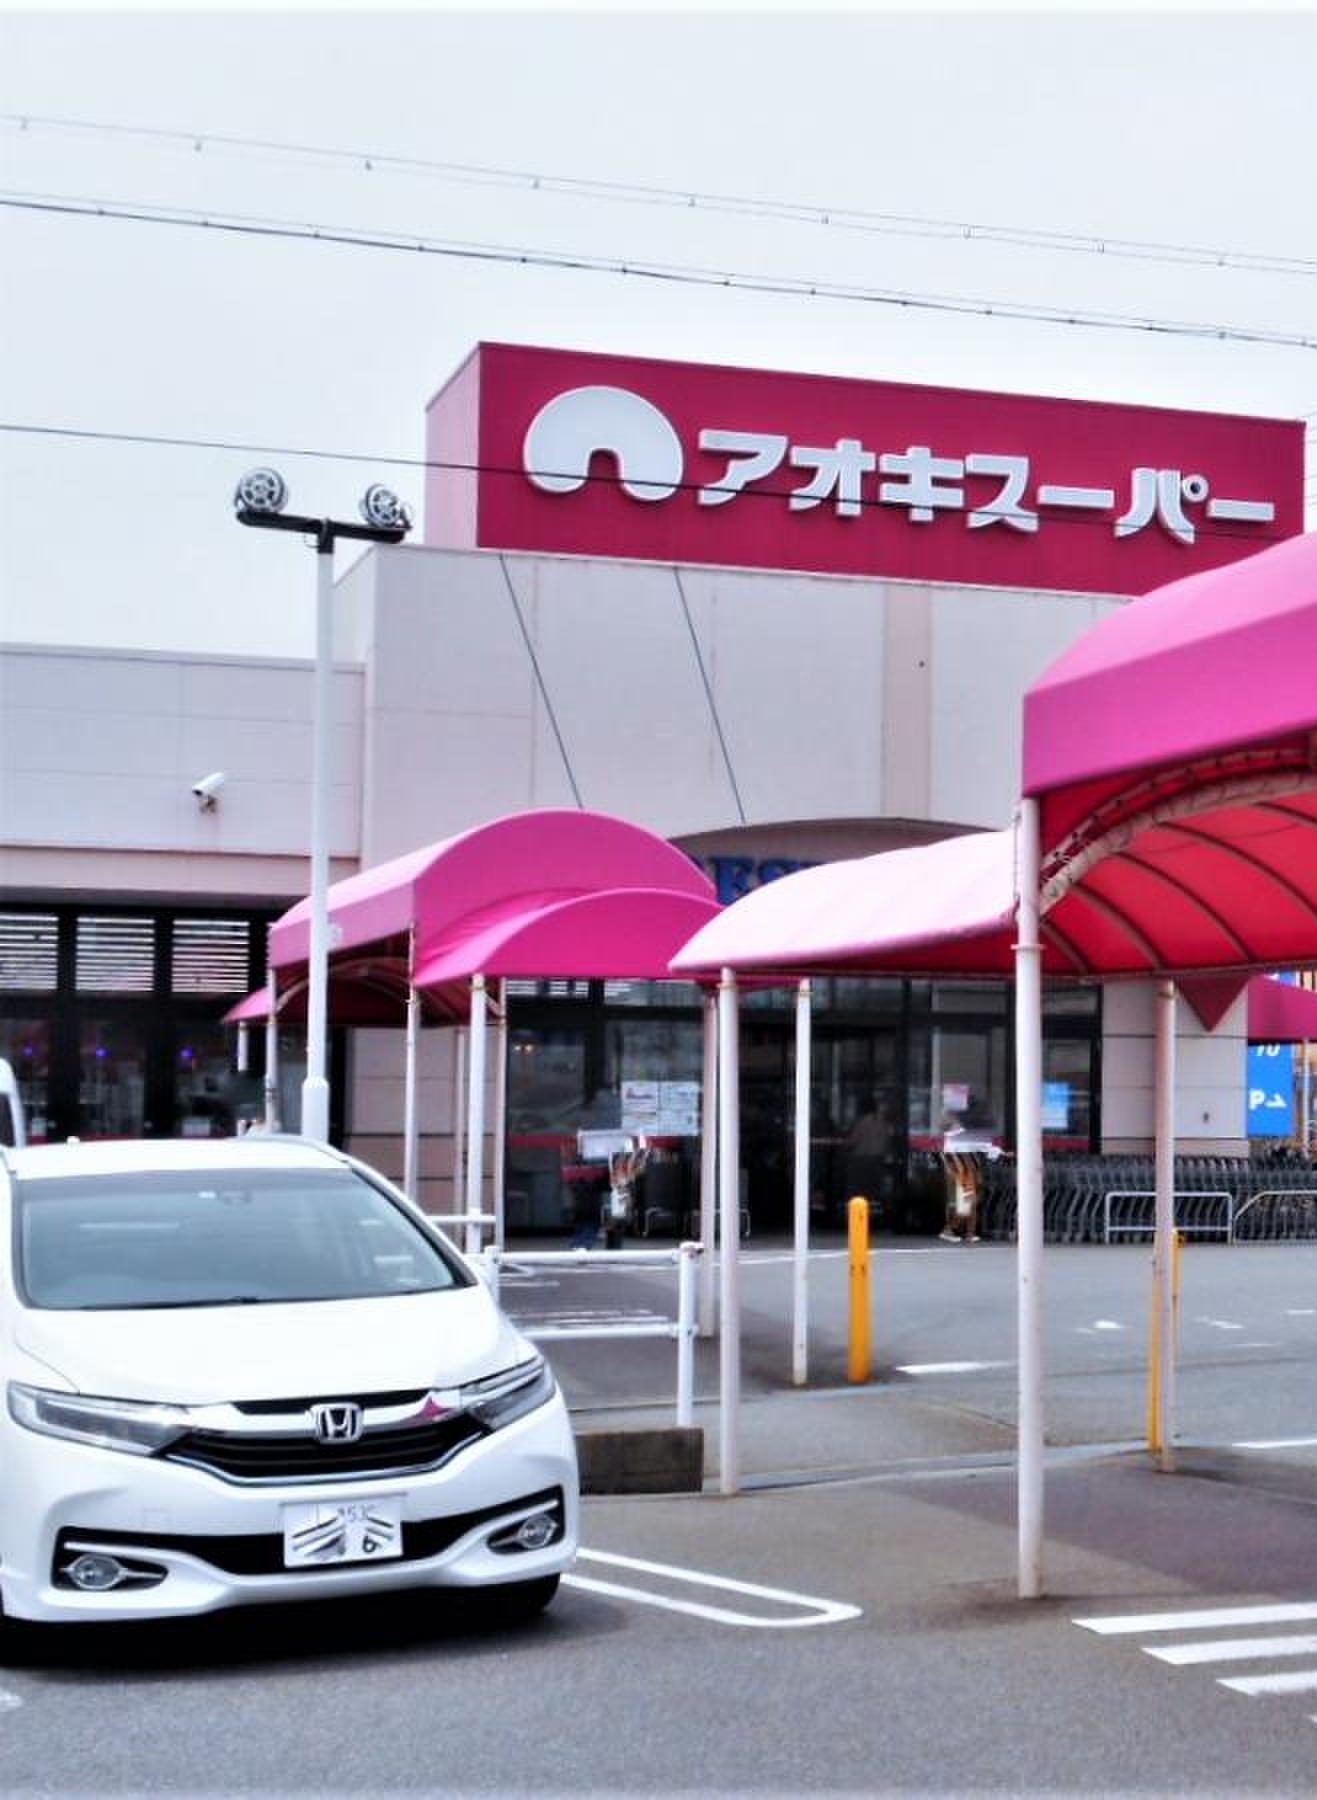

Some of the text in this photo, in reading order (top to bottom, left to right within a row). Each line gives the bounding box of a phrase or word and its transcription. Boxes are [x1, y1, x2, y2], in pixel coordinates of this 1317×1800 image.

[699, 429, 1274, 544] アオキスーパー
